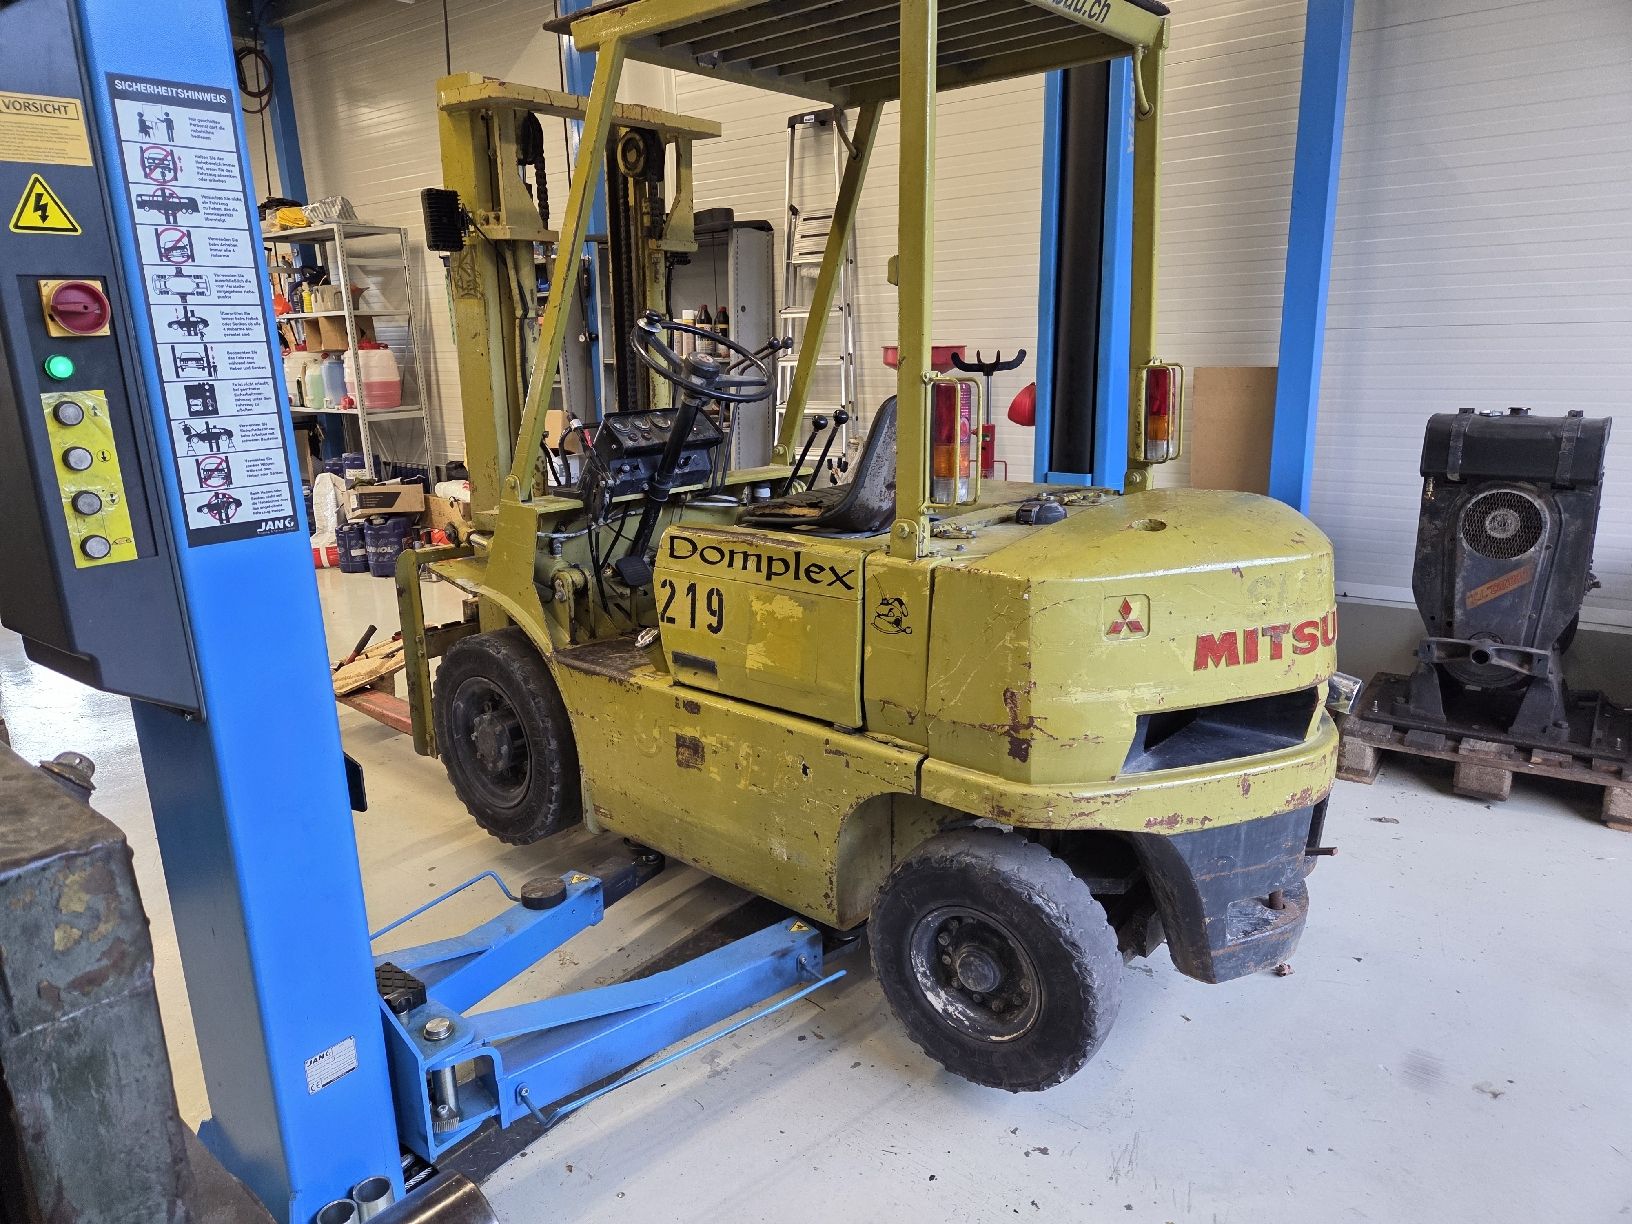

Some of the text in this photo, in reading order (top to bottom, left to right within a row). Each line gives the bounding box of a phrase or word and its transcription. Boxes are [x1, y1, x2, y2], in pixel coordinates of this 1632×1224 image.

[1, 98, 69, 116] VORSICHT
[114, 79, 227, 104] SICHERHEITSHINWEIS
[668, 535, 856, 591] Domplex
[660, 578, 725, 635] 219
[1193, 608, 1338, 672] MITSU
